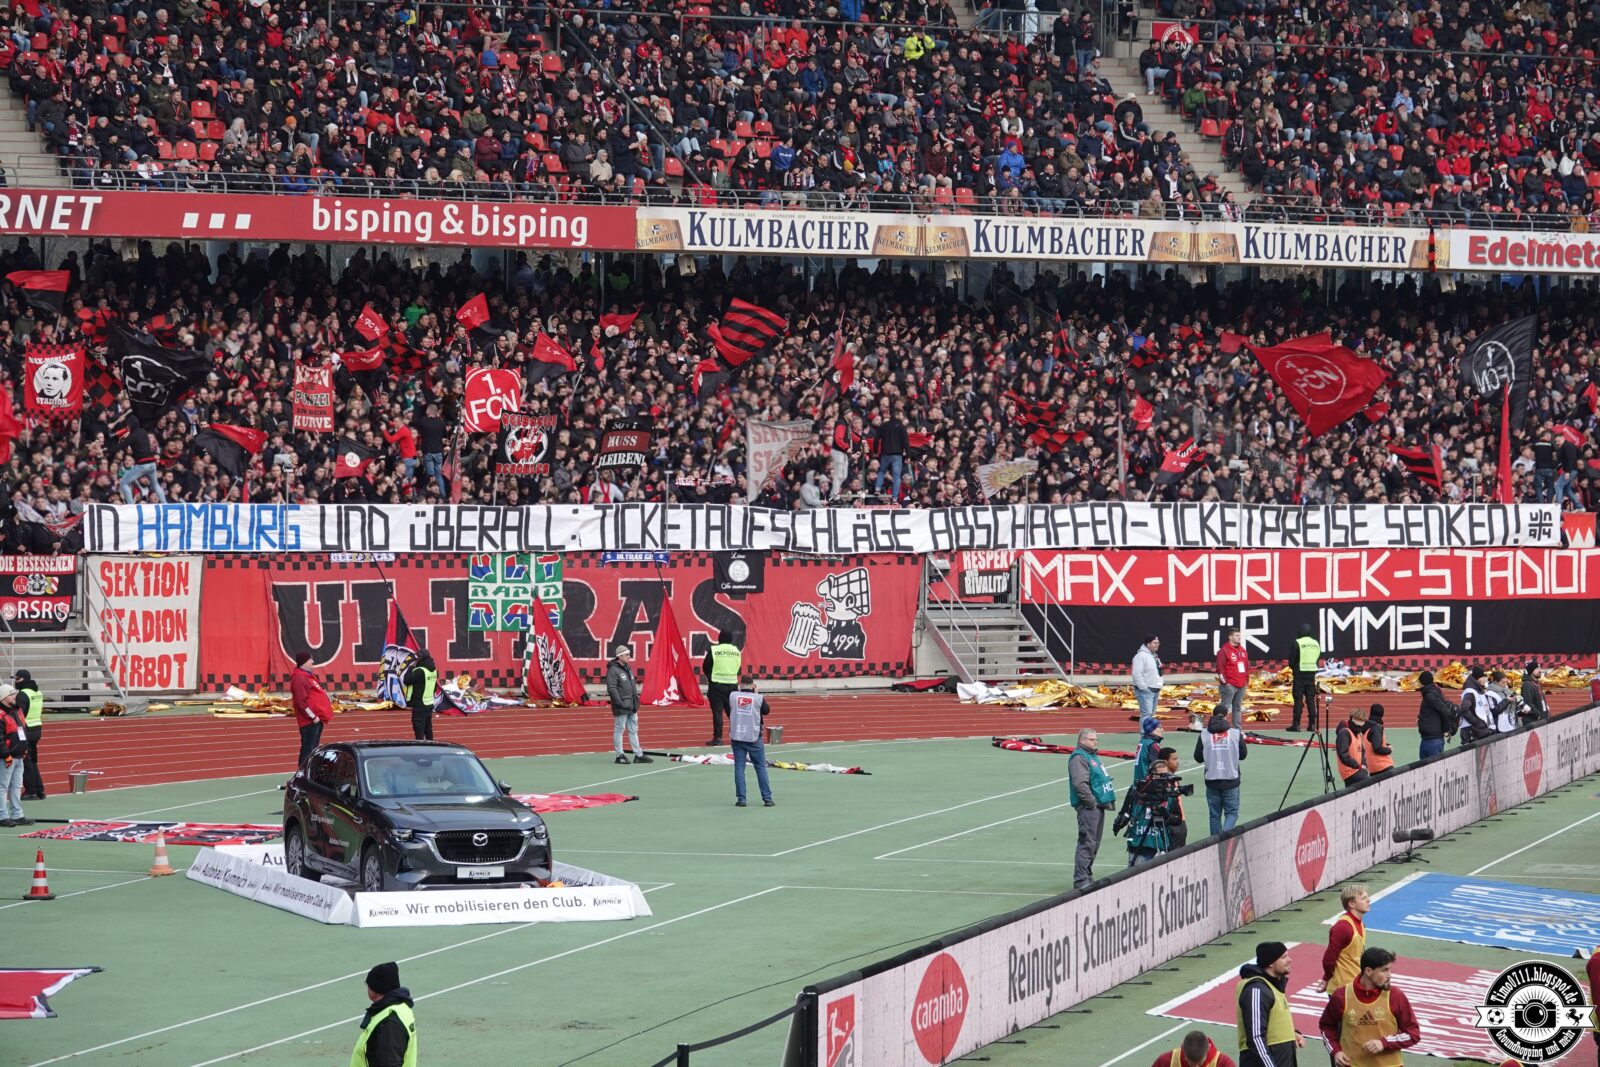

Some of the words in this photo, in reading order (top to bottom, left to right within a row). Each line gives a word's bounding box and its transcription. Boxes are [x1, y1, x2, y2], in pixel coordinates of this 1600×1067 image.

[312, 198, 433, 241] bisping
[440, 205, 464, 236] &
[472, 203, 588, 247] bisping
[688, 211, 869, 250] KULMBACHER
[973, 219, 1146, 257] KULMBACHER
[1243, 226, 1407, 264] KULMBACHER
[482, 373, 502, 395] 1.
[294, 415, 332, 429] KURVE
[470, 389, 519, 425] FCN
[607, 435, 638, 448] MUSS
[88, 504, 119, 550] IN
[136, 504, 301, 550] HAMBURG
[320, 505, 389, 550] UND
[593, 503, 911, 552] TICKETAUFSCHLÄGE
[1385, 502, 1521, 547] SENKEN!
[0, 555, 15, 572] DIE
[16, 555, 74, 572] BESESSENEN
[962, 550, 1017, 570] RESPEKT
[99, 560, 190, 597] SEKTION
[964, 572, 1010, 595] RIVALITÄ
[18, 601, 53, 619] RSR
[100, 608, 188, 644] STADION
[833, 634, 860, 651] 1994
[1351, 798, 1387, 858] Reinigen
[1393, 781, 1432, 832] Schmieren
[1438, 768, 1469, 817] Schützen
[262, 852, 287, 866] Au
[1297, 833, 1327, 867] caramba
[405, 903, 430, 915] Wir
[434, 899, 520, 913] mobilisieren
[523, 898, 549, 910] den
[551, 896, 587, 909] Club.
[1007, 932, 1071, 1006] Reinigen
[1082, 899, 1149, 974] Schmieren
[1157, 873, 1210, 939] Schützen
[915, 985, 965, 1031] caramba
